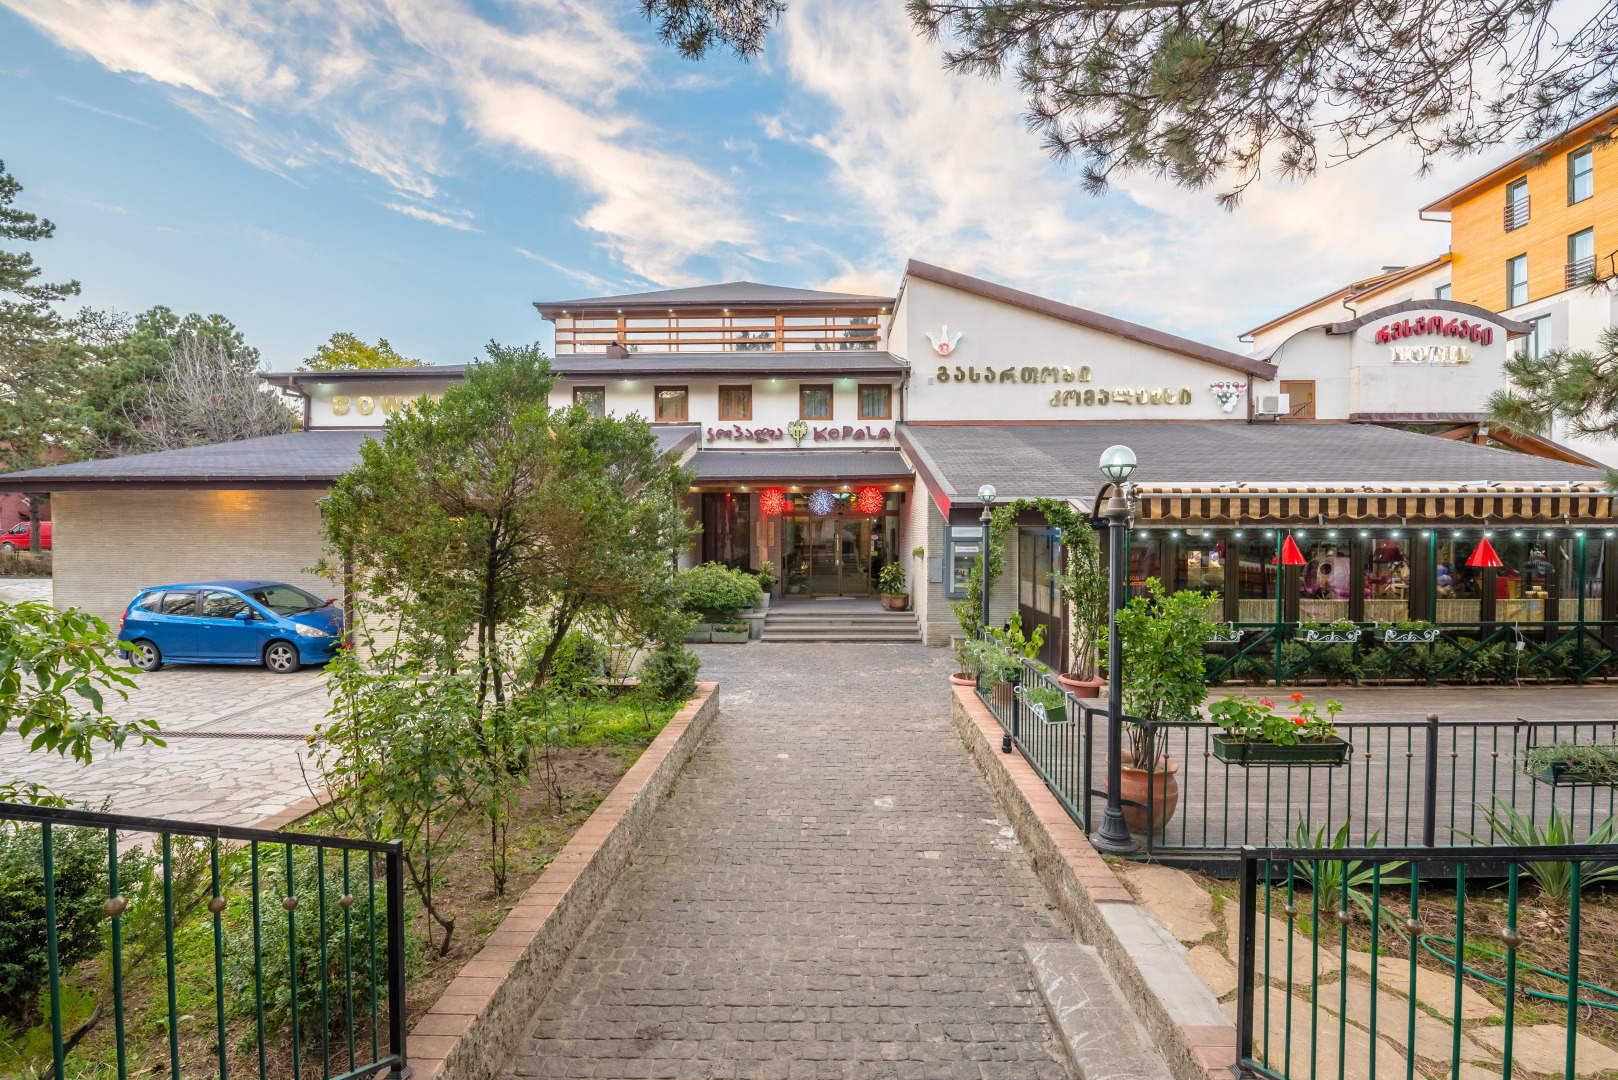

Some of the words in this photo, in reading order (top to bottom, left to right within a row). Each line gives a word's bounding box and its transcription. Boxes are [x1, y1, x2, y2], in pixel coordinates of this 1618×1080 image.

[1375, 316, 1493, 346] რესტორანი
[1390, 346, 1472, 363] HOTEL
[936, 365, 1092, 383] გასართობი
[1049, 387, 1192, 406] კომპლექსი
[706, 424, 783, 442] კოპალა
[813, 426, 891, 441] KOPALA
